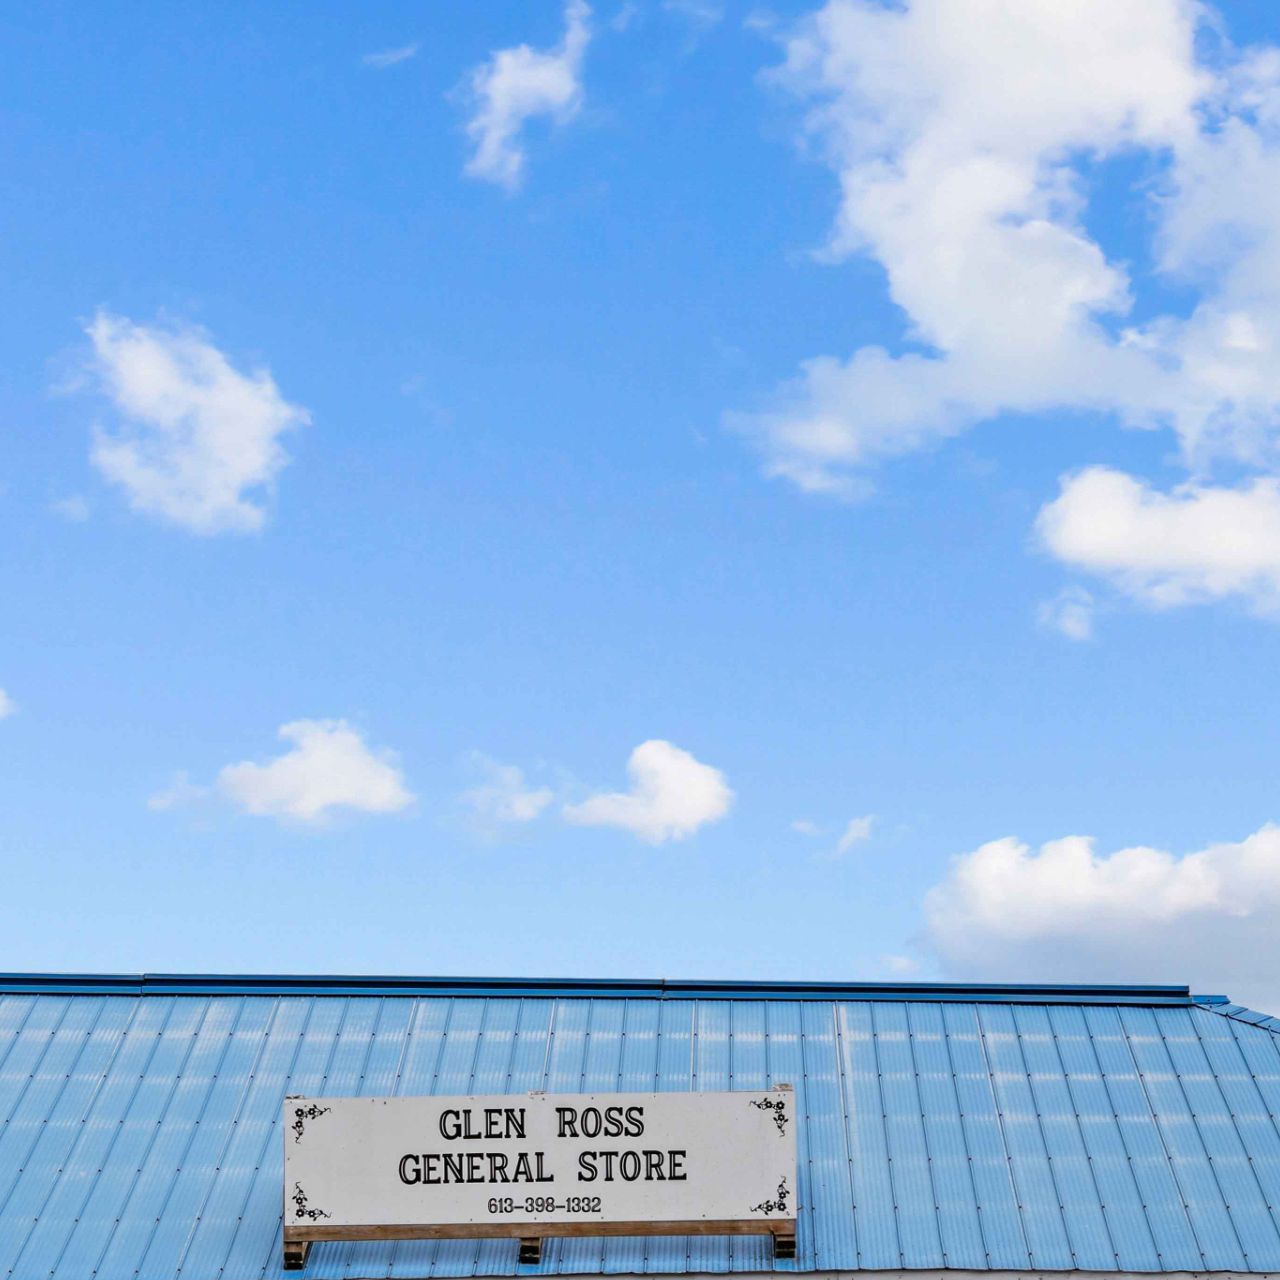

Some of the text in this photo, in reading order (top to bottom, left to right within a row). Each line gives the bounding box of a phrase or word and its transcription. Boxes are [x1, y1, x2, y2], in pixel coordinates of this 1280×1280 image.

[438, 1106, 645, 1140] GLEN ROSS
[399, 1150, 688, 1185] GENERAL STORE
[487, 1197, 601, 1215] 613-398-1332
